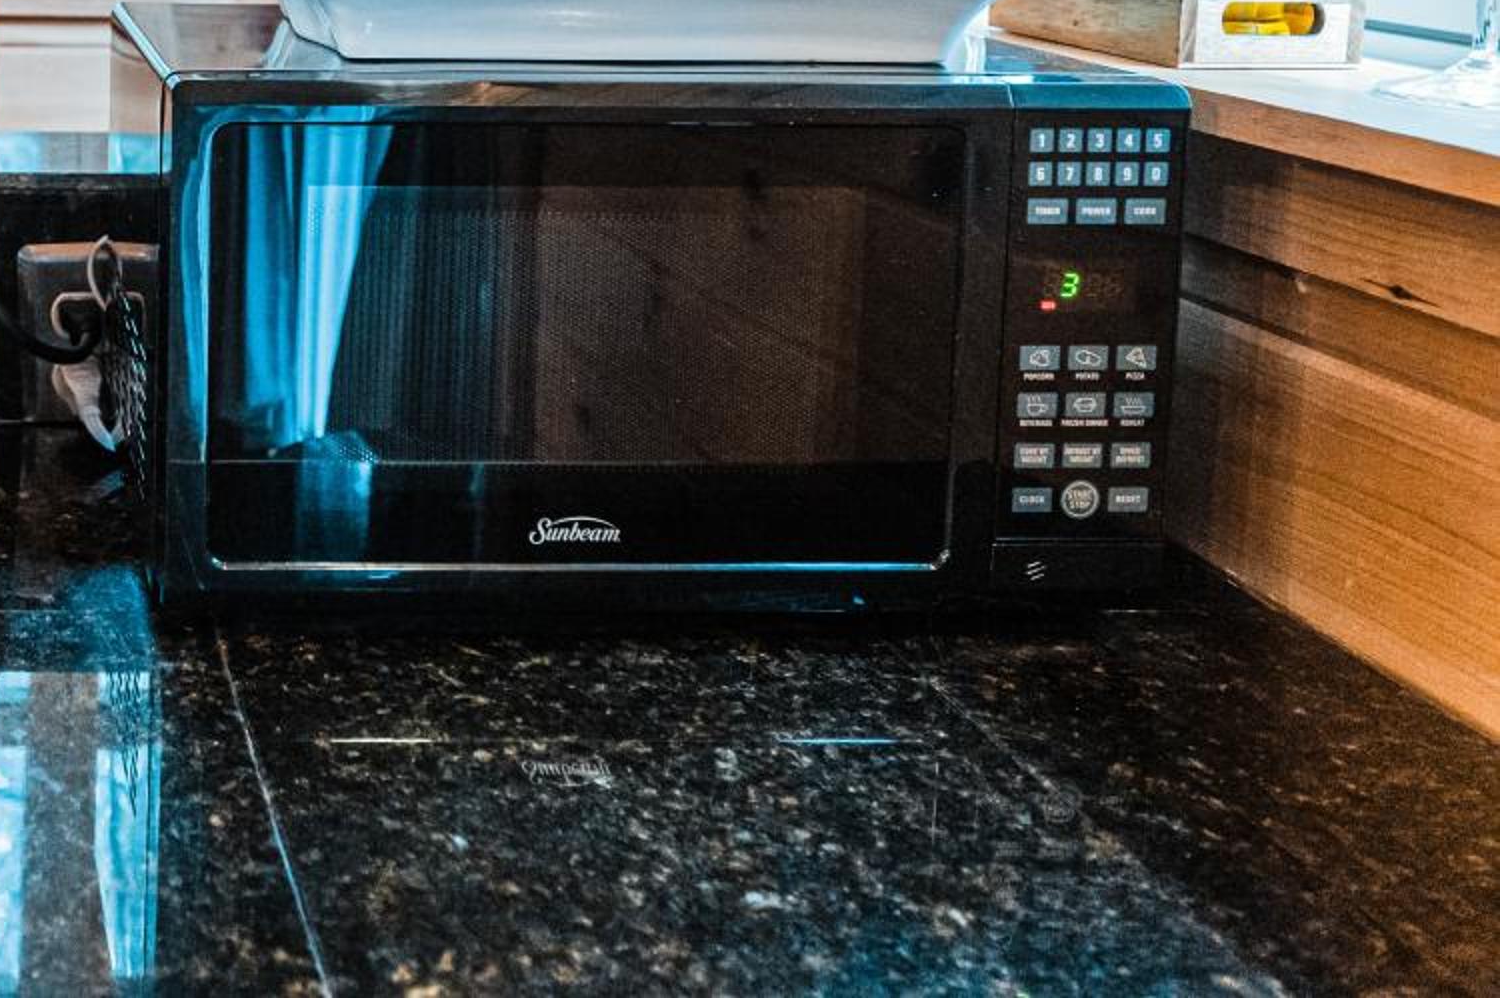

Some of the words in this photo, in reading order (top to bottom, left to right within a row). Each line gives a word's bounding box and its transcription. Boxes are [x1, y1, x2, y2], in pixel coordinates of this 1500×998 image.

[1038, 133, 1046, 148] 1
[1066, 133, 1076, 148] 2
[1095, 133, 1105, 148] 3
[1123, 133, 1133, 148] 4
[1153, 133, 1163, 148] 5
[1035, 167, 1045, 181] 6
[1065, 167, 1073, 181] 7
[1094, 167, 1103, 181] 8
[1123, 167, 1132, 181] 9
[1152, 167, 1161, 181] 0
[1060, 272, 1081, 298] 3
[1069, 501, 1091, 510] STOP
[529, 516, 621, 545] Sunbeam
